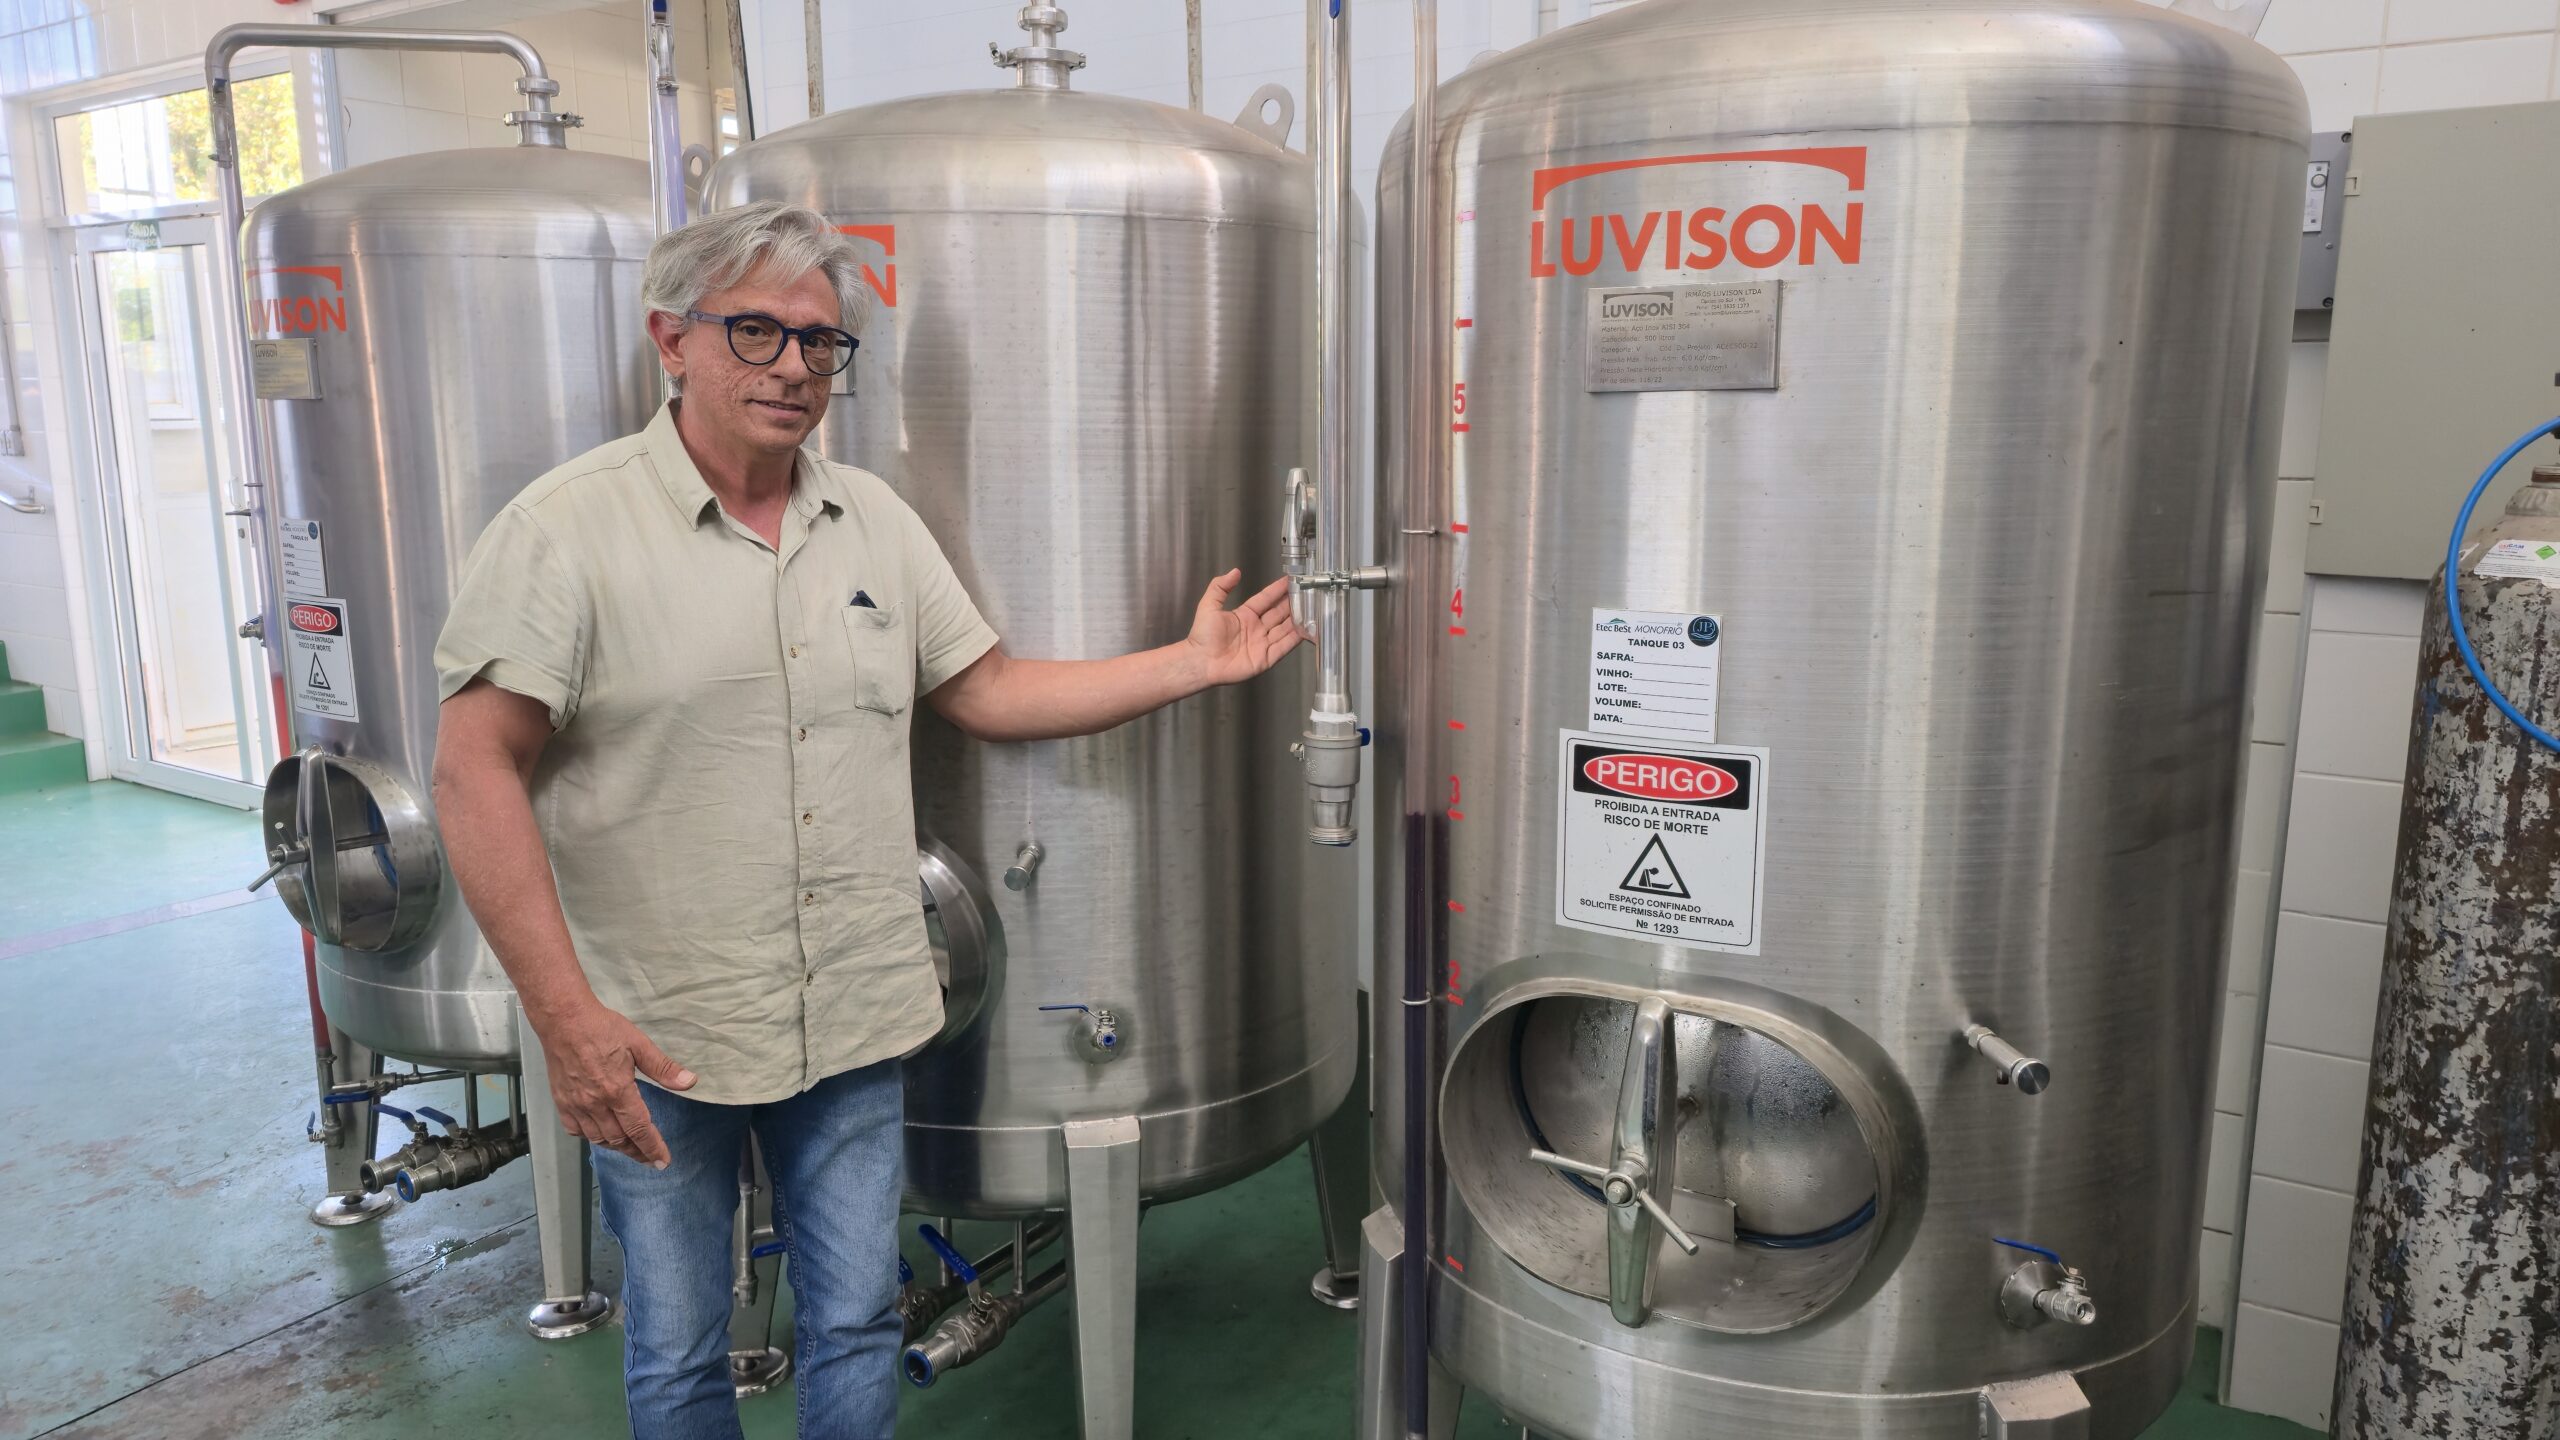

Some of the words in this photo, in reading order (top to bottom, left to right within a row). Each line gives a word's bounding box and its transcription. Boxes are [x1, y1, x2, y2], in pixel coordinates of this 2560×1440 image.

[1530, 202, 1865, 279] LUVISON
[1602, 302, 1674, 318] LUVISON
[1454, 383, 1466, 415] 5
[1450, 588, 1463, 619] 4
[292, 609, 332, 628] PERIGO
[1595, 623, 1613, 632] Etec
[1613, 624, 1632, 633] BeSt
[1627, 638, 1670, 649] TANQUE
[1672, 641, 1685, 650] 03
[1596, 651, 1635, 663] SAFRA:
[1596, 668, 1633, 679] VINHO:
[1597, 682, 1627, 693] LOTE:
[1595, 697, 1642, 709] VOLUME:
[1593, 713, 1623, 724] DATA:
[1597, 759, 1722, 795] PERIGO
[1449, 774, 1461, 806] 3
[1594, 798, 1649, 815] PROIBIDA
[1651, 805, 1660, 816] A
[1662, 807, 1721, 822] ENTRADA
[1604, 813, 1641, 828] RISCO
[1644, 819, 1660, 830] DE
[1663, 822, 1709, 836] MORTE
[1579, 897, 1618, 912] SOLICITE
[1619, 904, 1672, 920] PERMISSÃO
[1674, 912, 1686, 922] DE
[1689, 915, 1735, 928] ENTRADA
[1609, 893, 1645, 906] ESPAÇO
[1646, 899, 1702, 914] CONFINADO
[1653, 922, 1679, 935] 1293
[1448, 959, 1461, 991] 2
